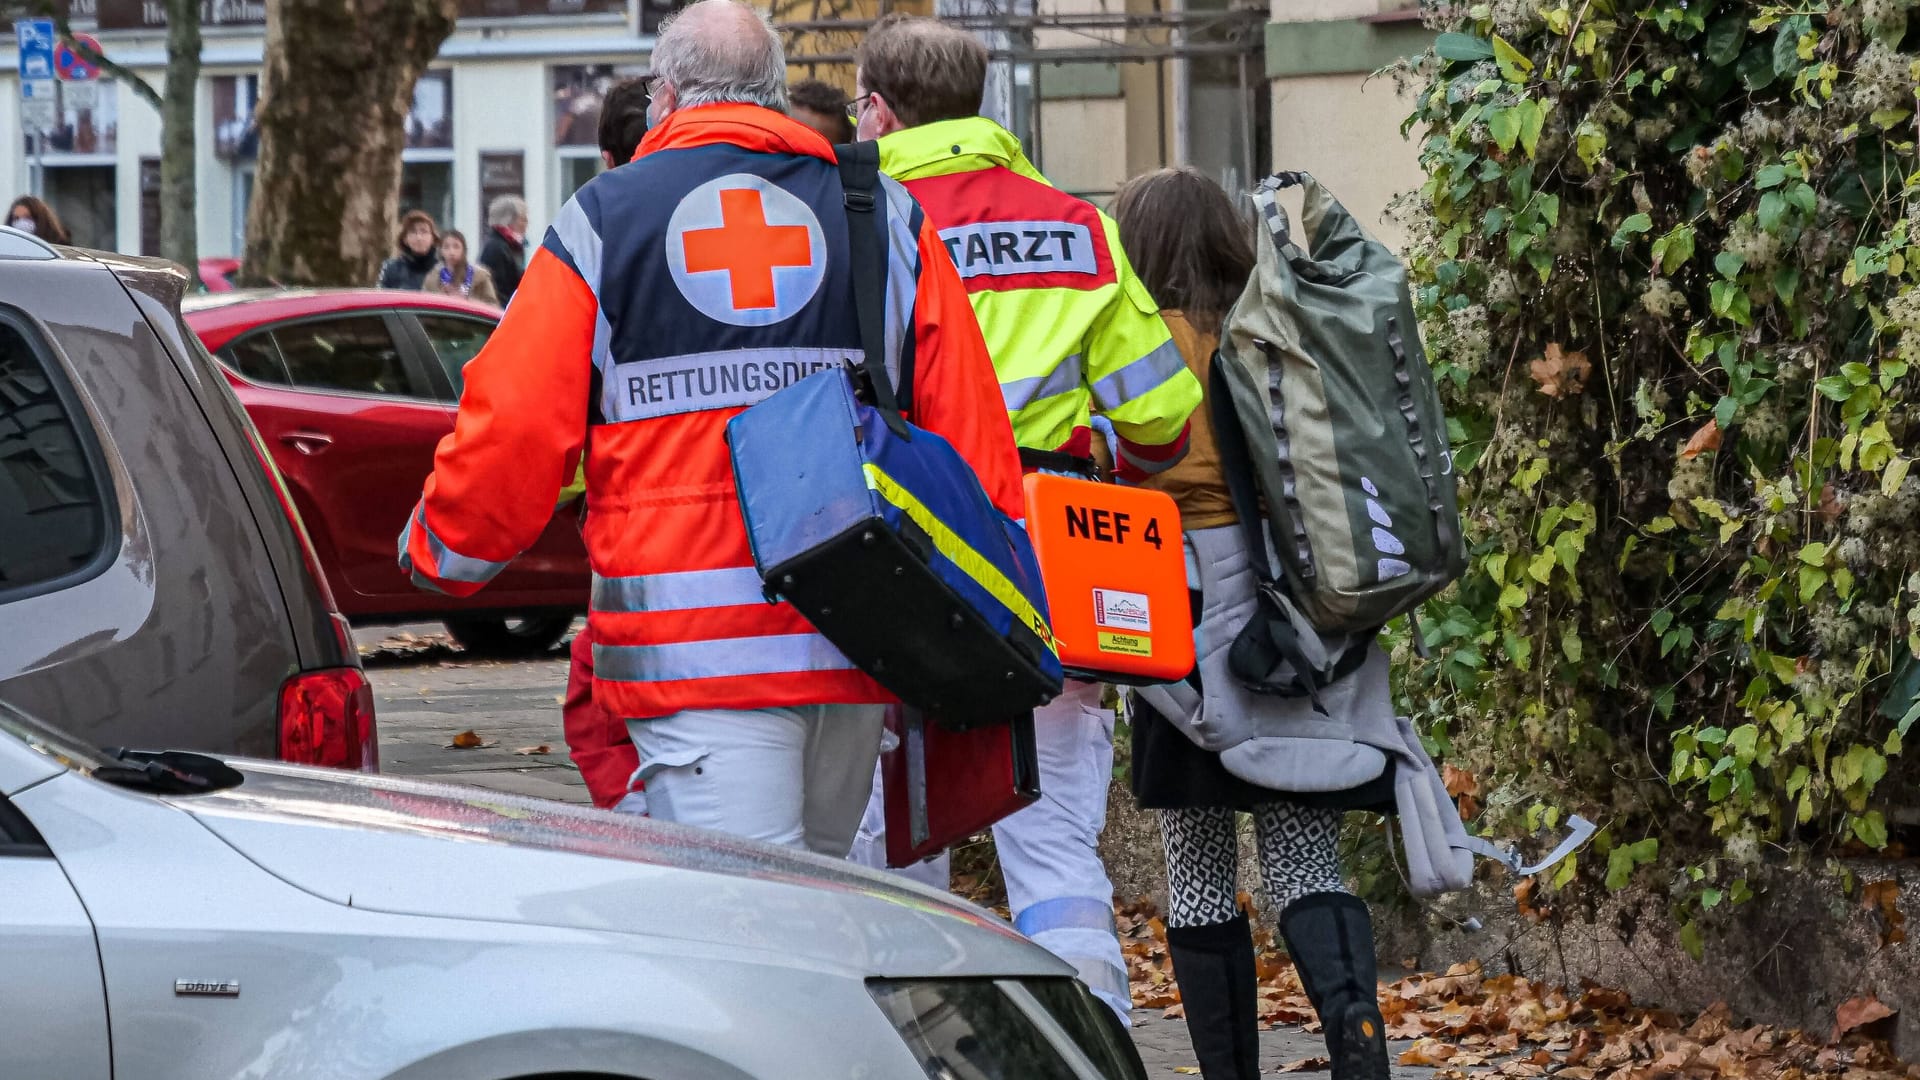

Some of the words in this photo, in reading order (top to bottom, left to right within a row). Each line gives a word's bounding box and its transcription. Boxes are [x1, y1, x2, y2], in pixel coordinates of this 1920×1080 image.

[943, 230, 1076, 269] TARZT
[1065, 505, 1130, 544] NEF
[1144, 517, 1162, 551] 4
[1111, 635, 1138, 647] Achtung
[185, 983, 228, 993] DRIVE
